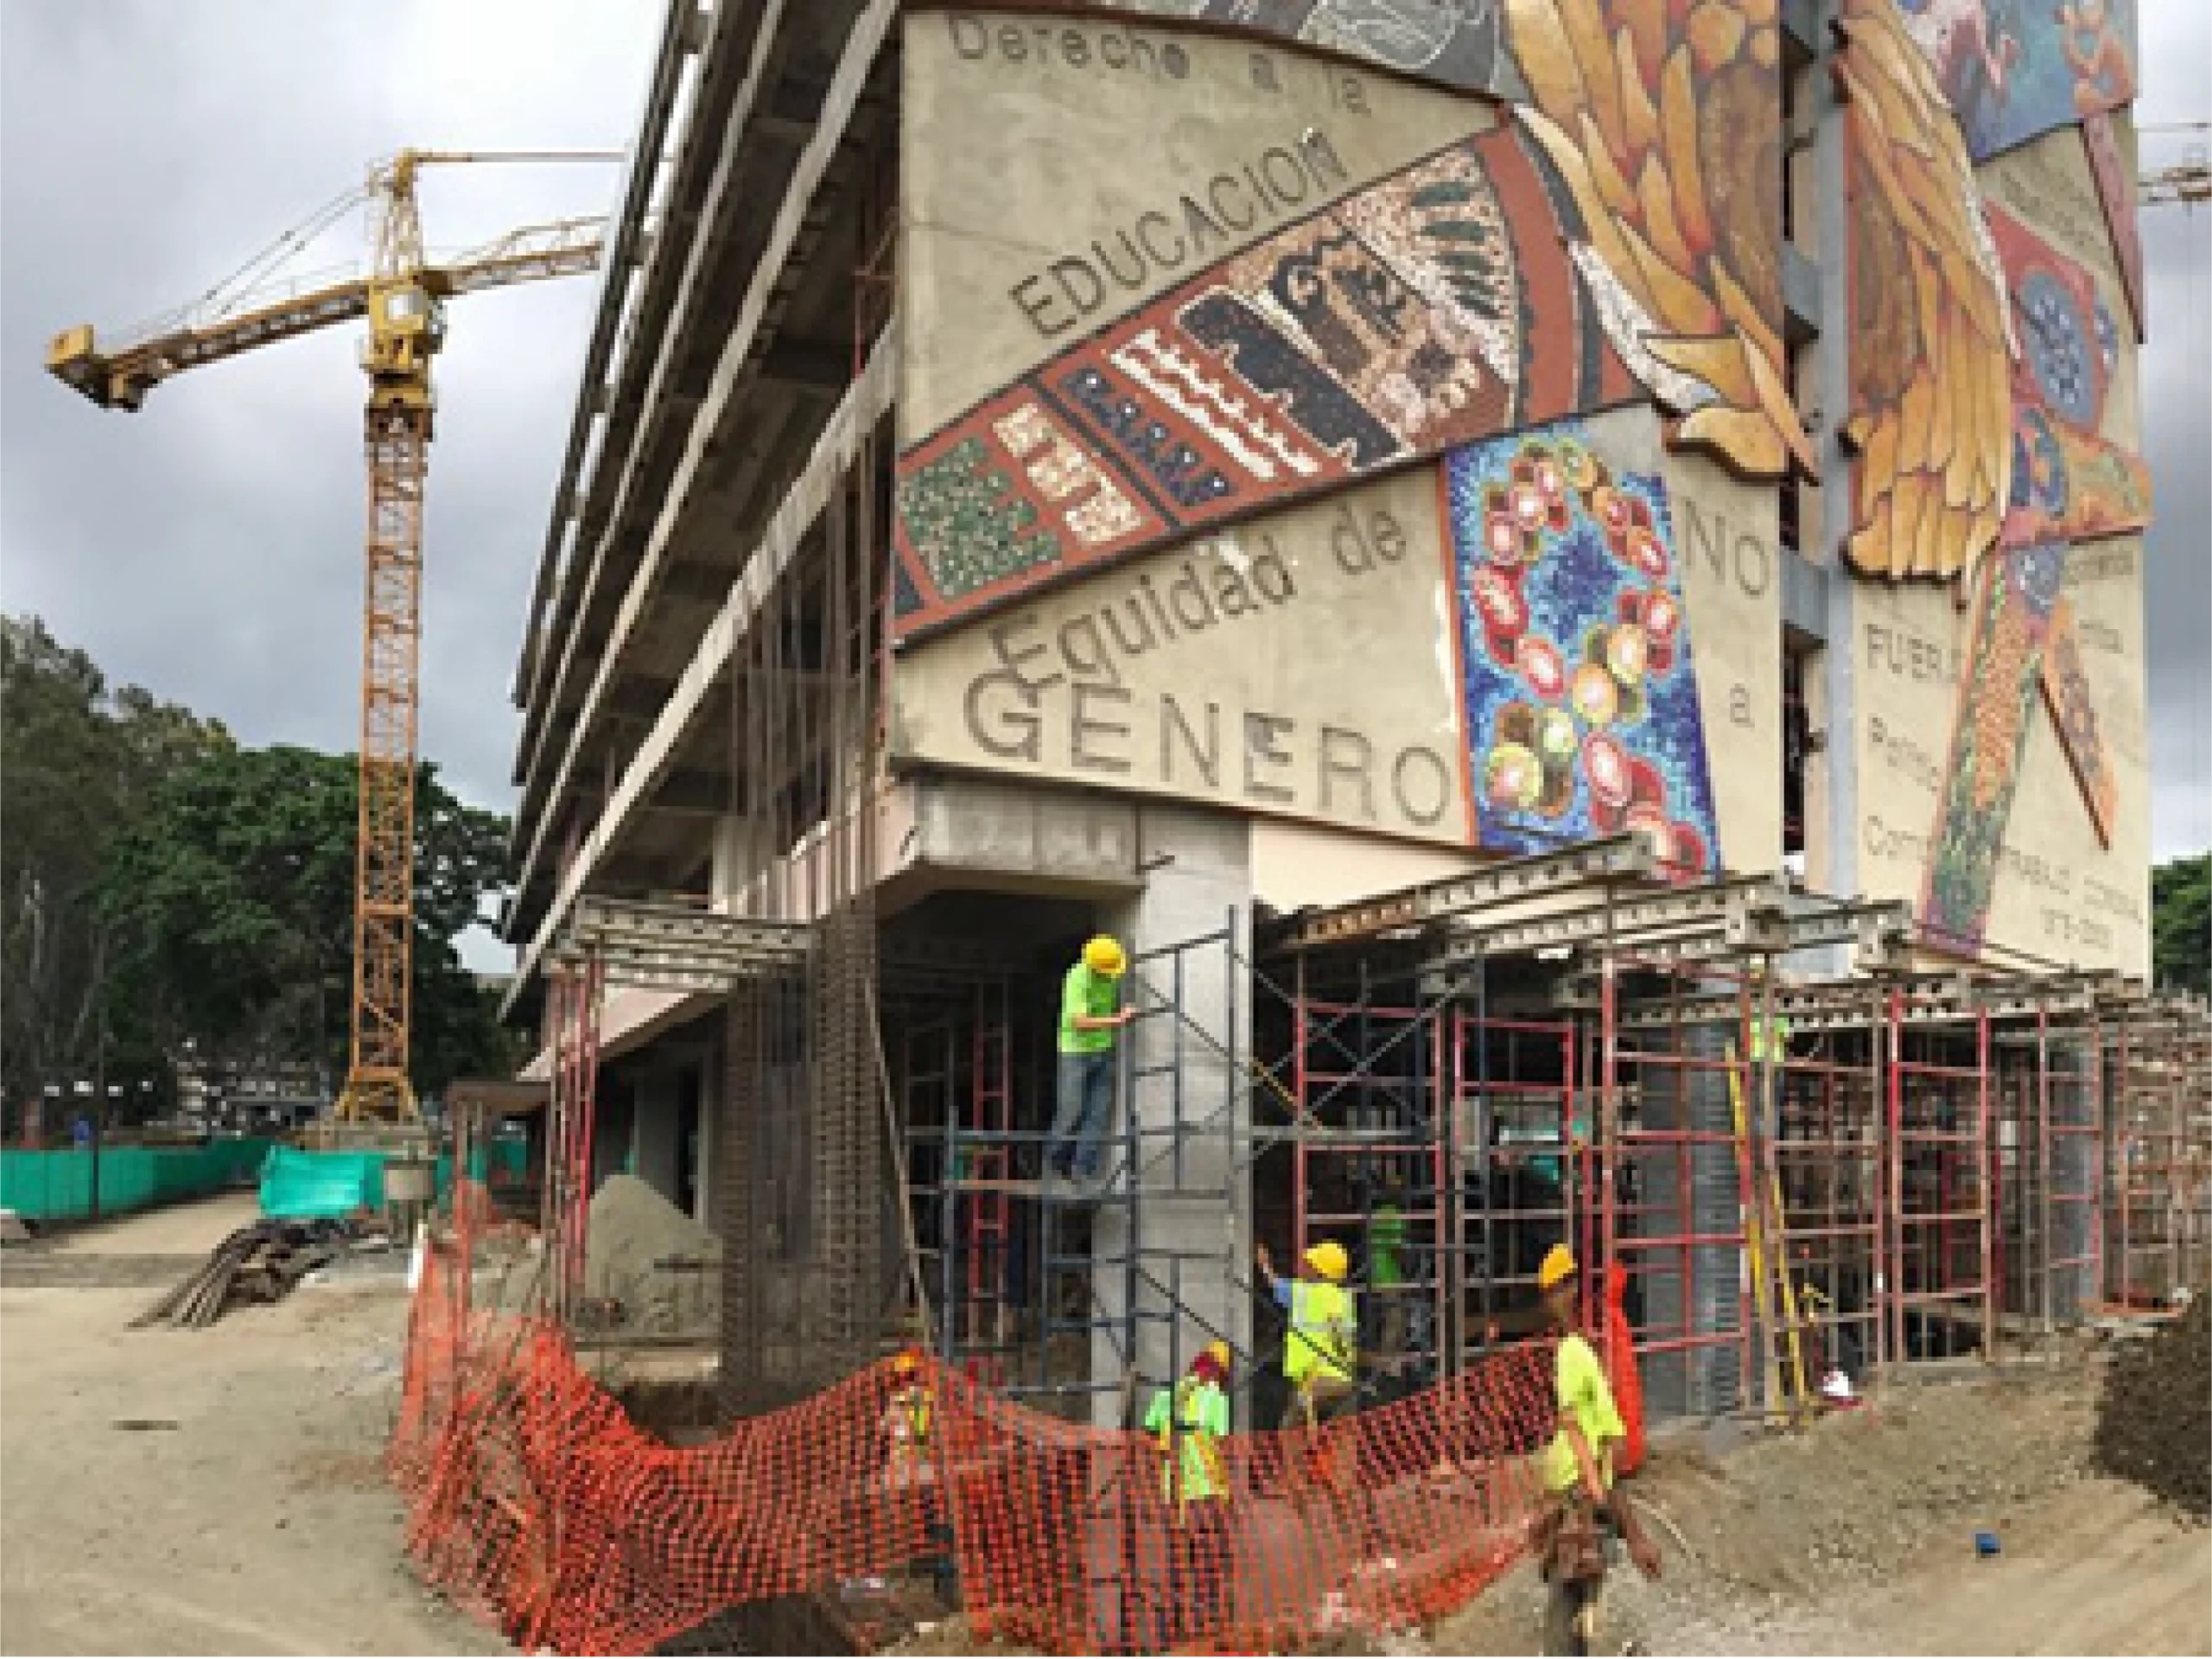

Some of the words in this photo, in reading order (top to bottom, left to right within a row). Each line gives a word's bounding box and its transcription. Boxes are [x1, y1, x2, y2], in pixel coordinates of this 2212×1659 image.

[1008, 129, 1348, 338] EDUCACION
[991, 536, 1296, 691] Equidad
[1331, 505, 1407, 575] de
[963, 671, 1452, 826] GENERO
